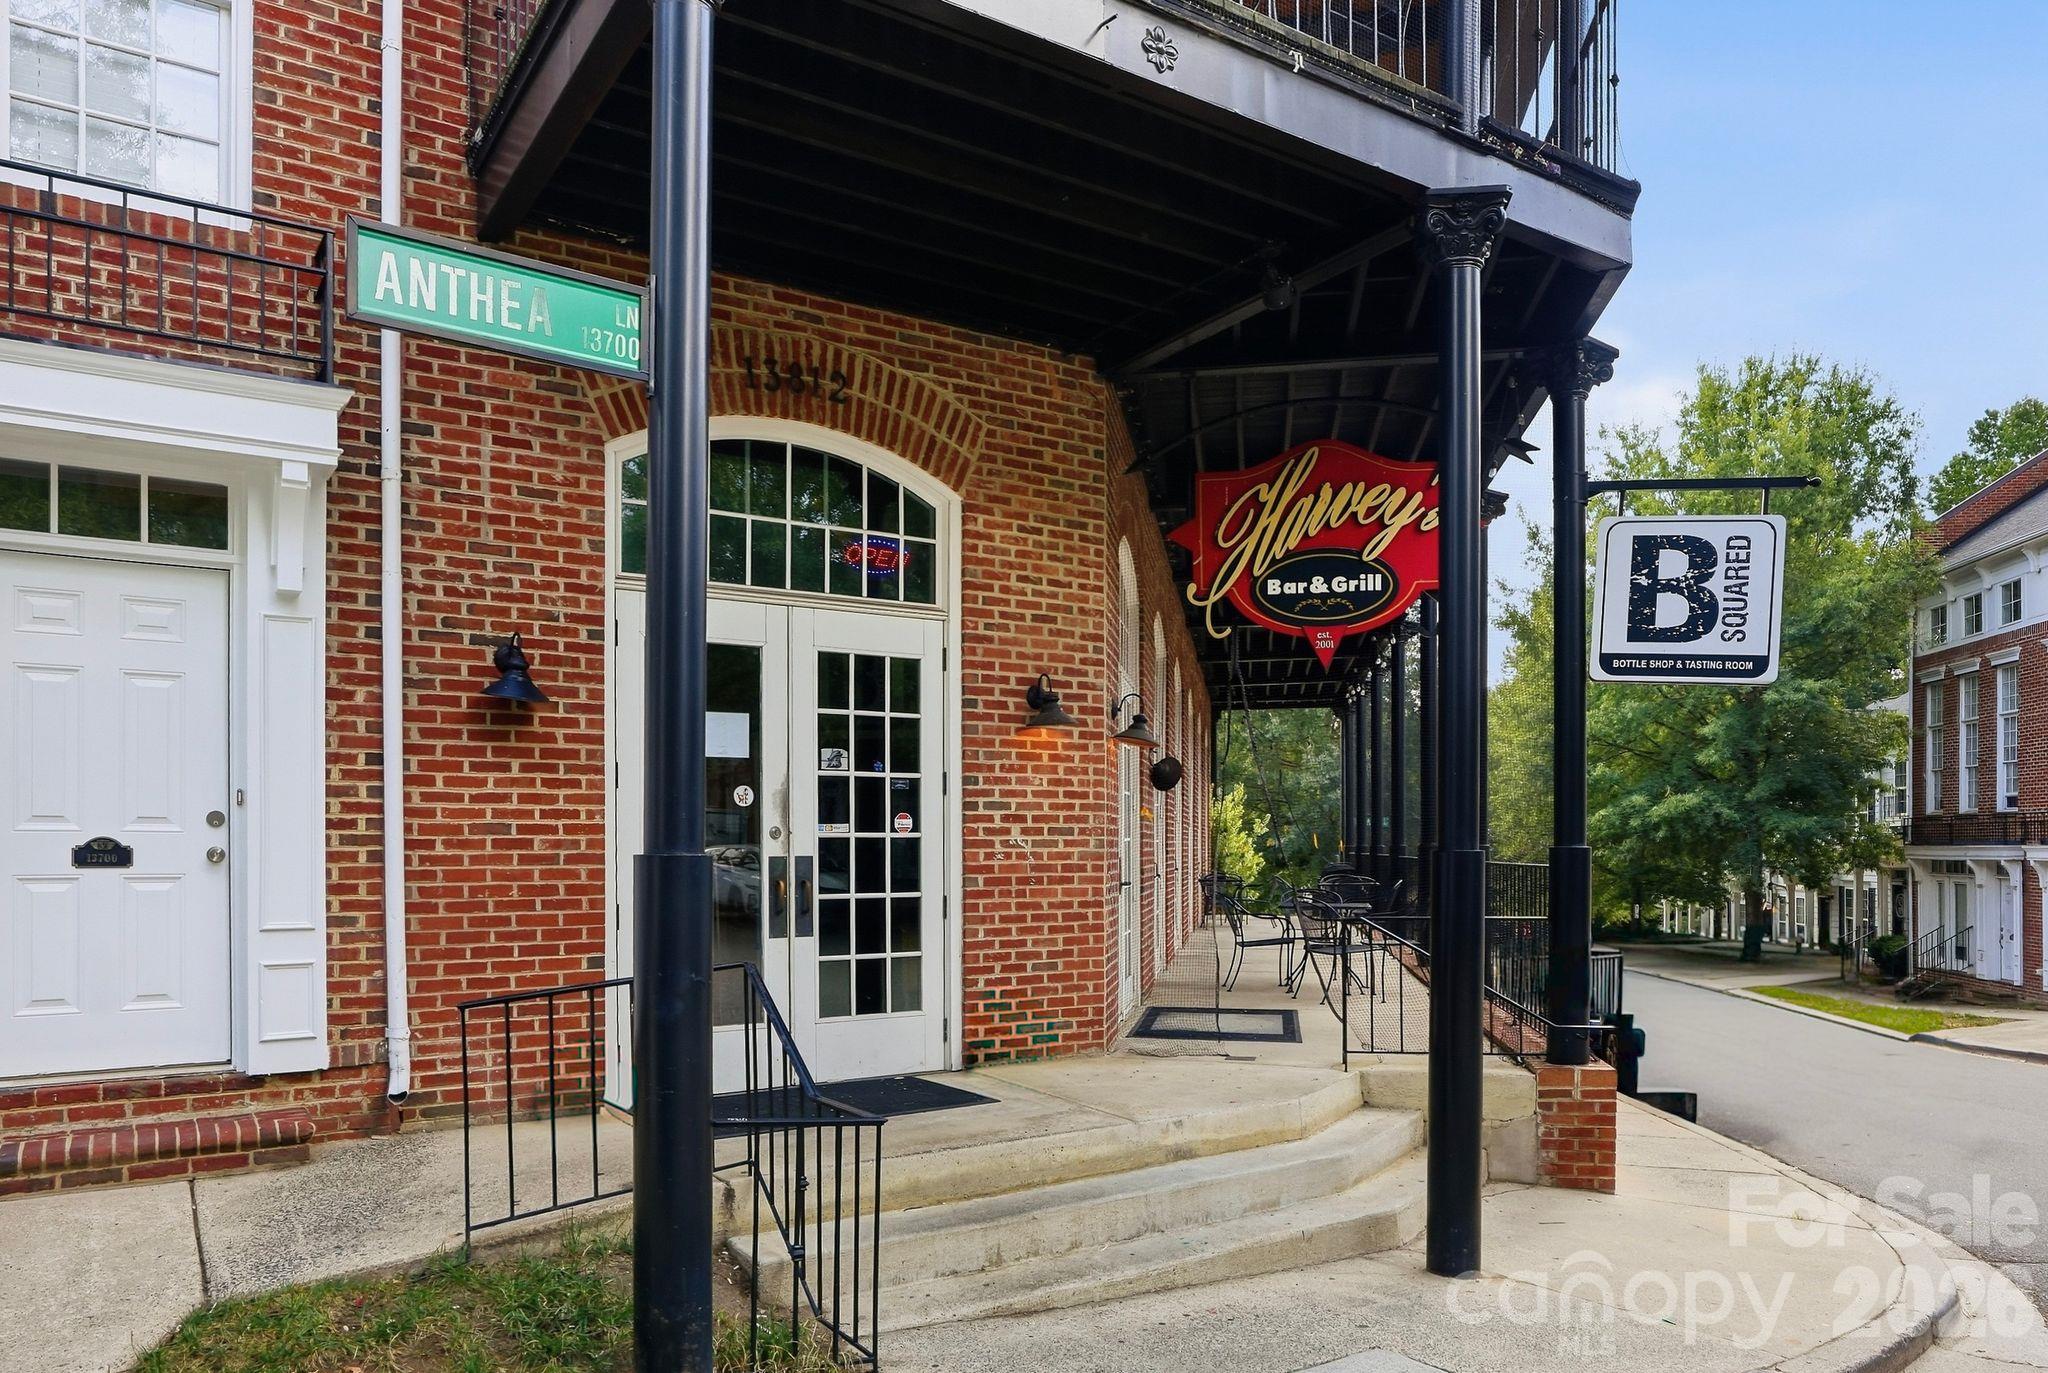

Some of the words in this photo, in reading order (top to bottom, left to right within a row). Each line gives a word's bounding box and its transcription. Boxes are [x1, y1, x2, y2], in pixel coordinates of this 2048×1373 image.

[374, 250, 553, 337] ANTHEA
[615, 303, 640, 330] LN
[581, 325, 640, 361] 13700
[744, 355, 847, 404] 13812
[845, 544, 911, 568] OPEN
[1626, 534, 1720, 643] B
[1720, 534, 1752, 643] SQUARED
[1315, 640, 1335, 649] 2001
[1316, 631, 1333, 639] est.
[1612, 659, 1648, 669] BOTTLE
[1649, 659, 1675, 670] SHOP
[1676, 660, 1684, 670] &
[1684, 660, 1724, 670] TASTING
[1725, 661, 1754, 671] ROOM
